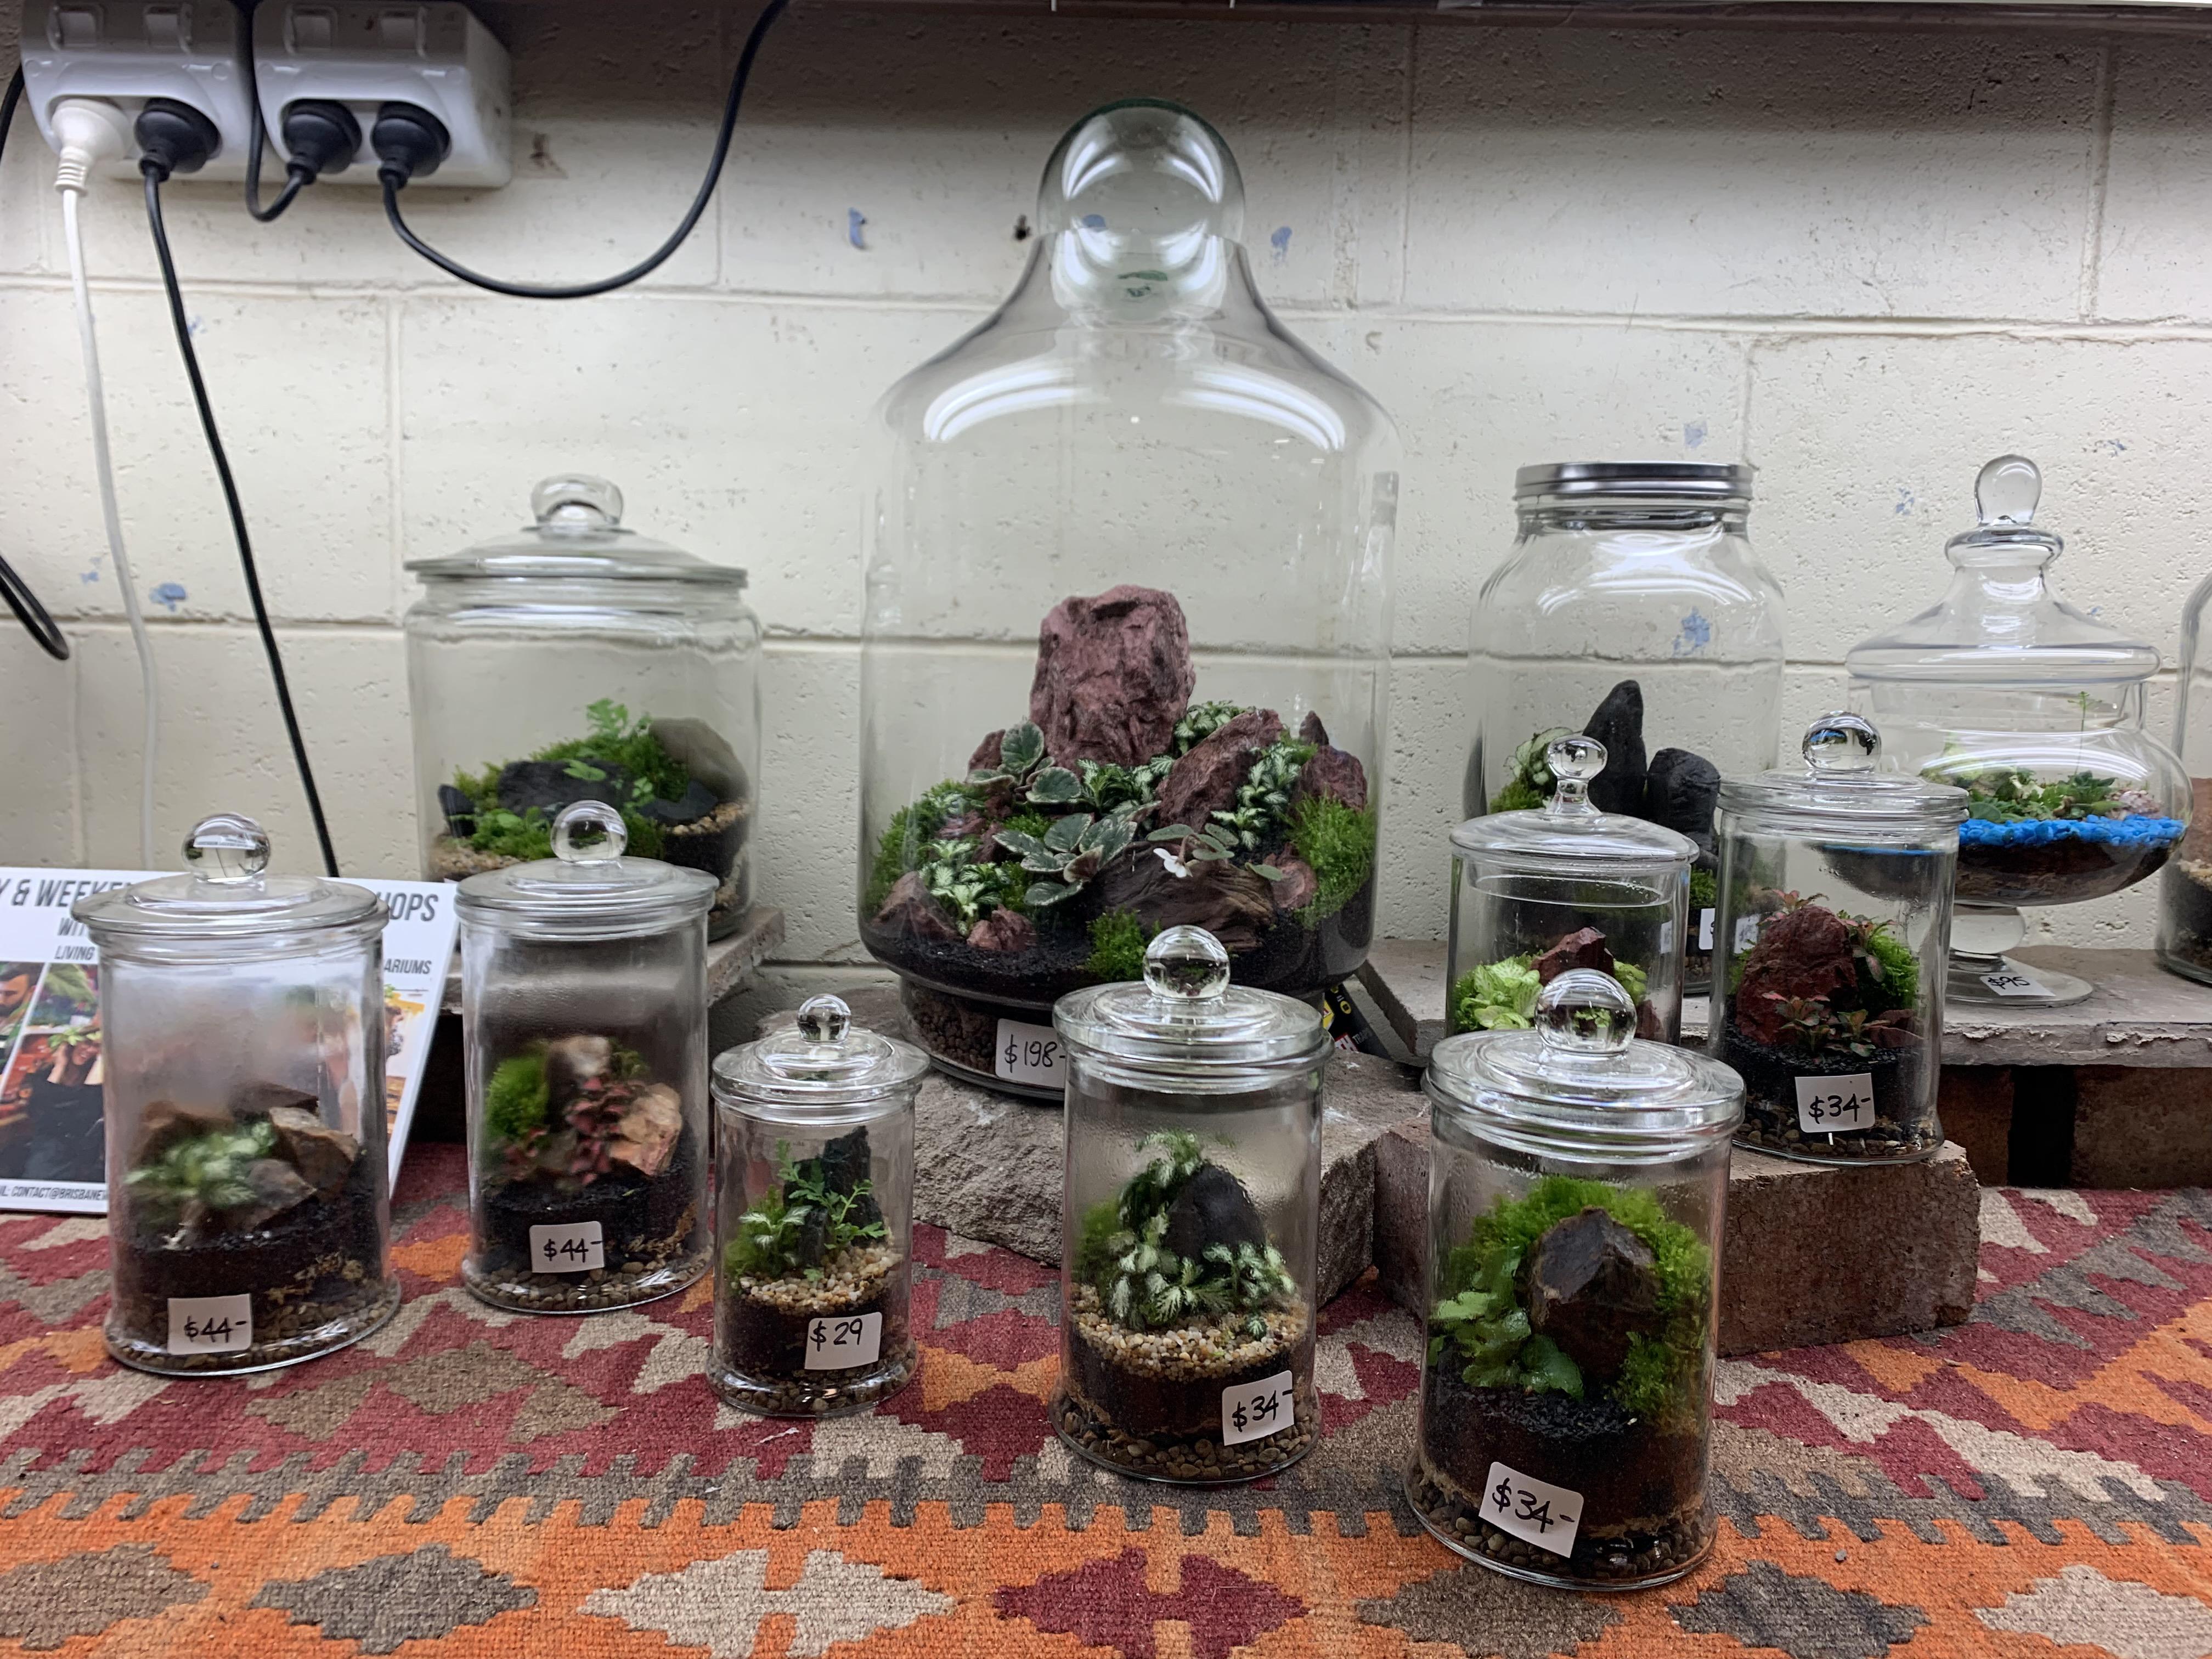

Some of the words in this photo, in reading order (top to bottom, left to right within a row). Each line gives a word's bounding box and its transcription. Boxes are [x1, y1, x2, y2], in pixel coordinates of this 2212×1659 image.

[11, 879, 31, 906] &
[54, 945, 95, 961] LIVING
[1988, 976, 2030, 990] $95
[810, 1318, 863, 1352] $29
